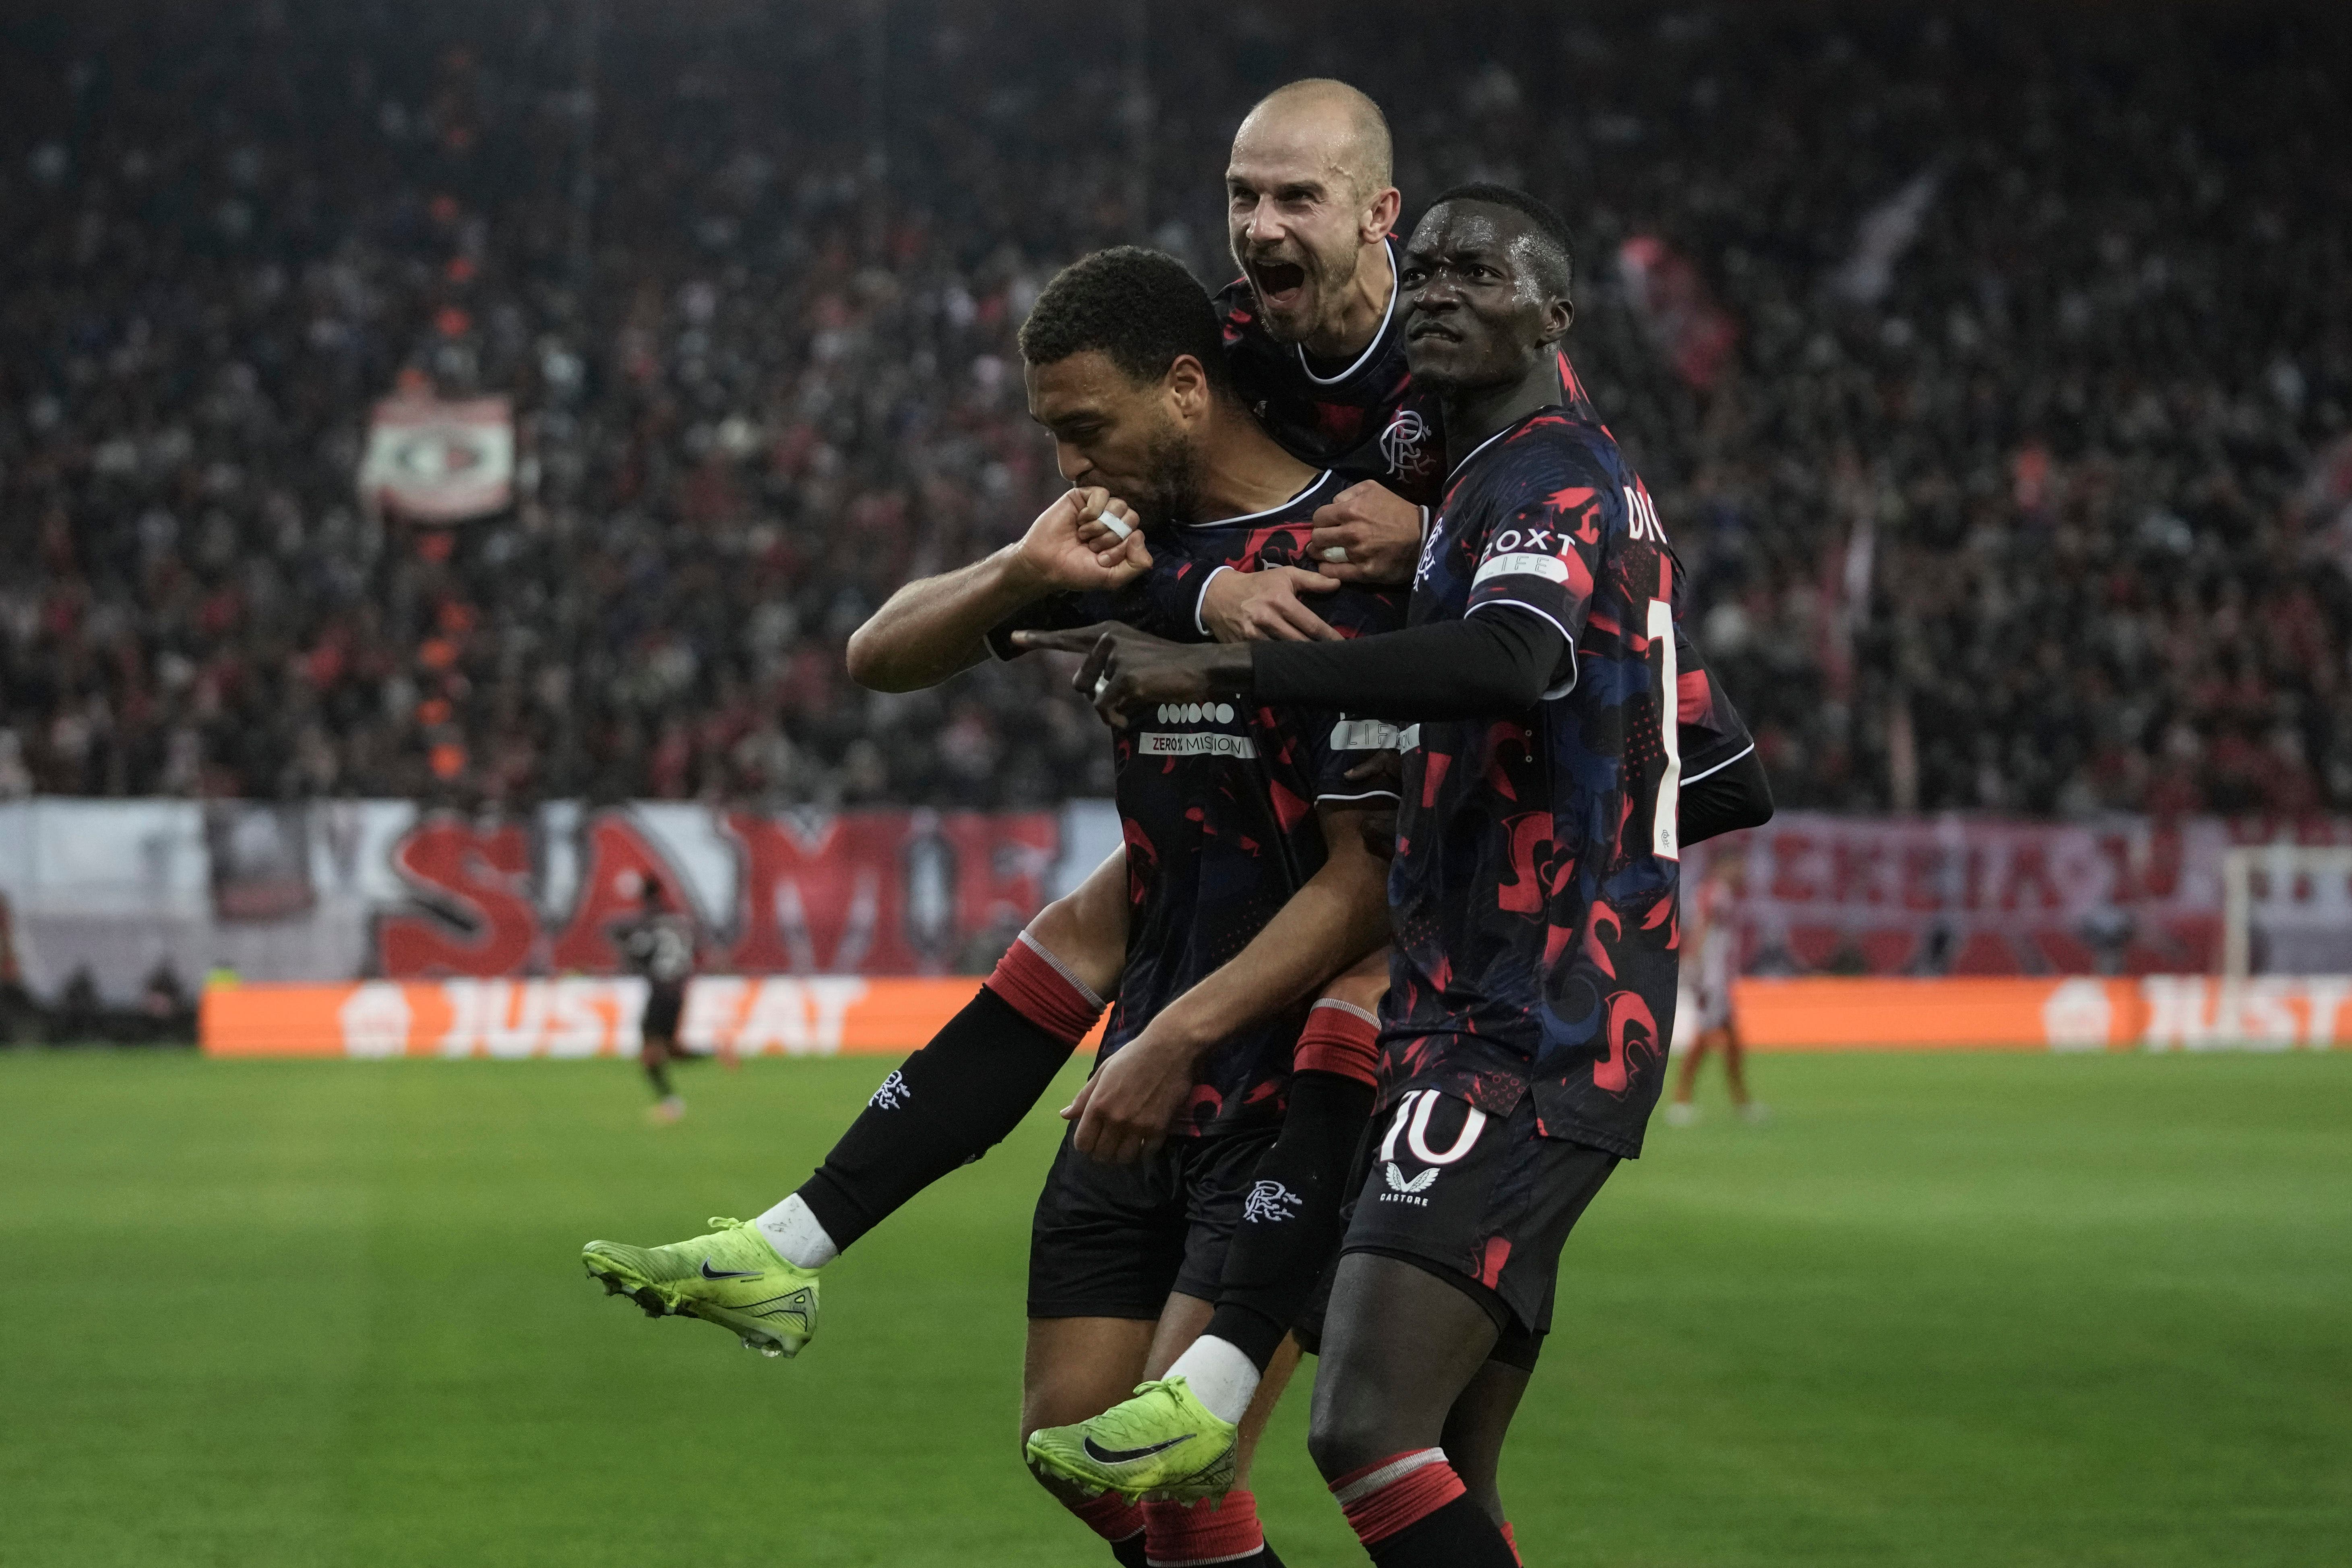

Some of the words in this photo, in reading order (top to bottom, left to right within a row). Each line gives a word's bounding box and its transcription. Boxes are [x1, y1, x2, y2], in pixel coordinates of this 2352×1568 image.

[1485, 555, 1550, 576] LIFE
[1153, 737, 1183, 751] ZERO%
[441, 976, 651, 1058] JUST
[680, 975, 866, 1057] EAT
[2141, 973, 2352, 1052] JUST
[1381, 1089, 1487, 1164] 10
[1380, 1193, 1428, 1207] CASTORE
